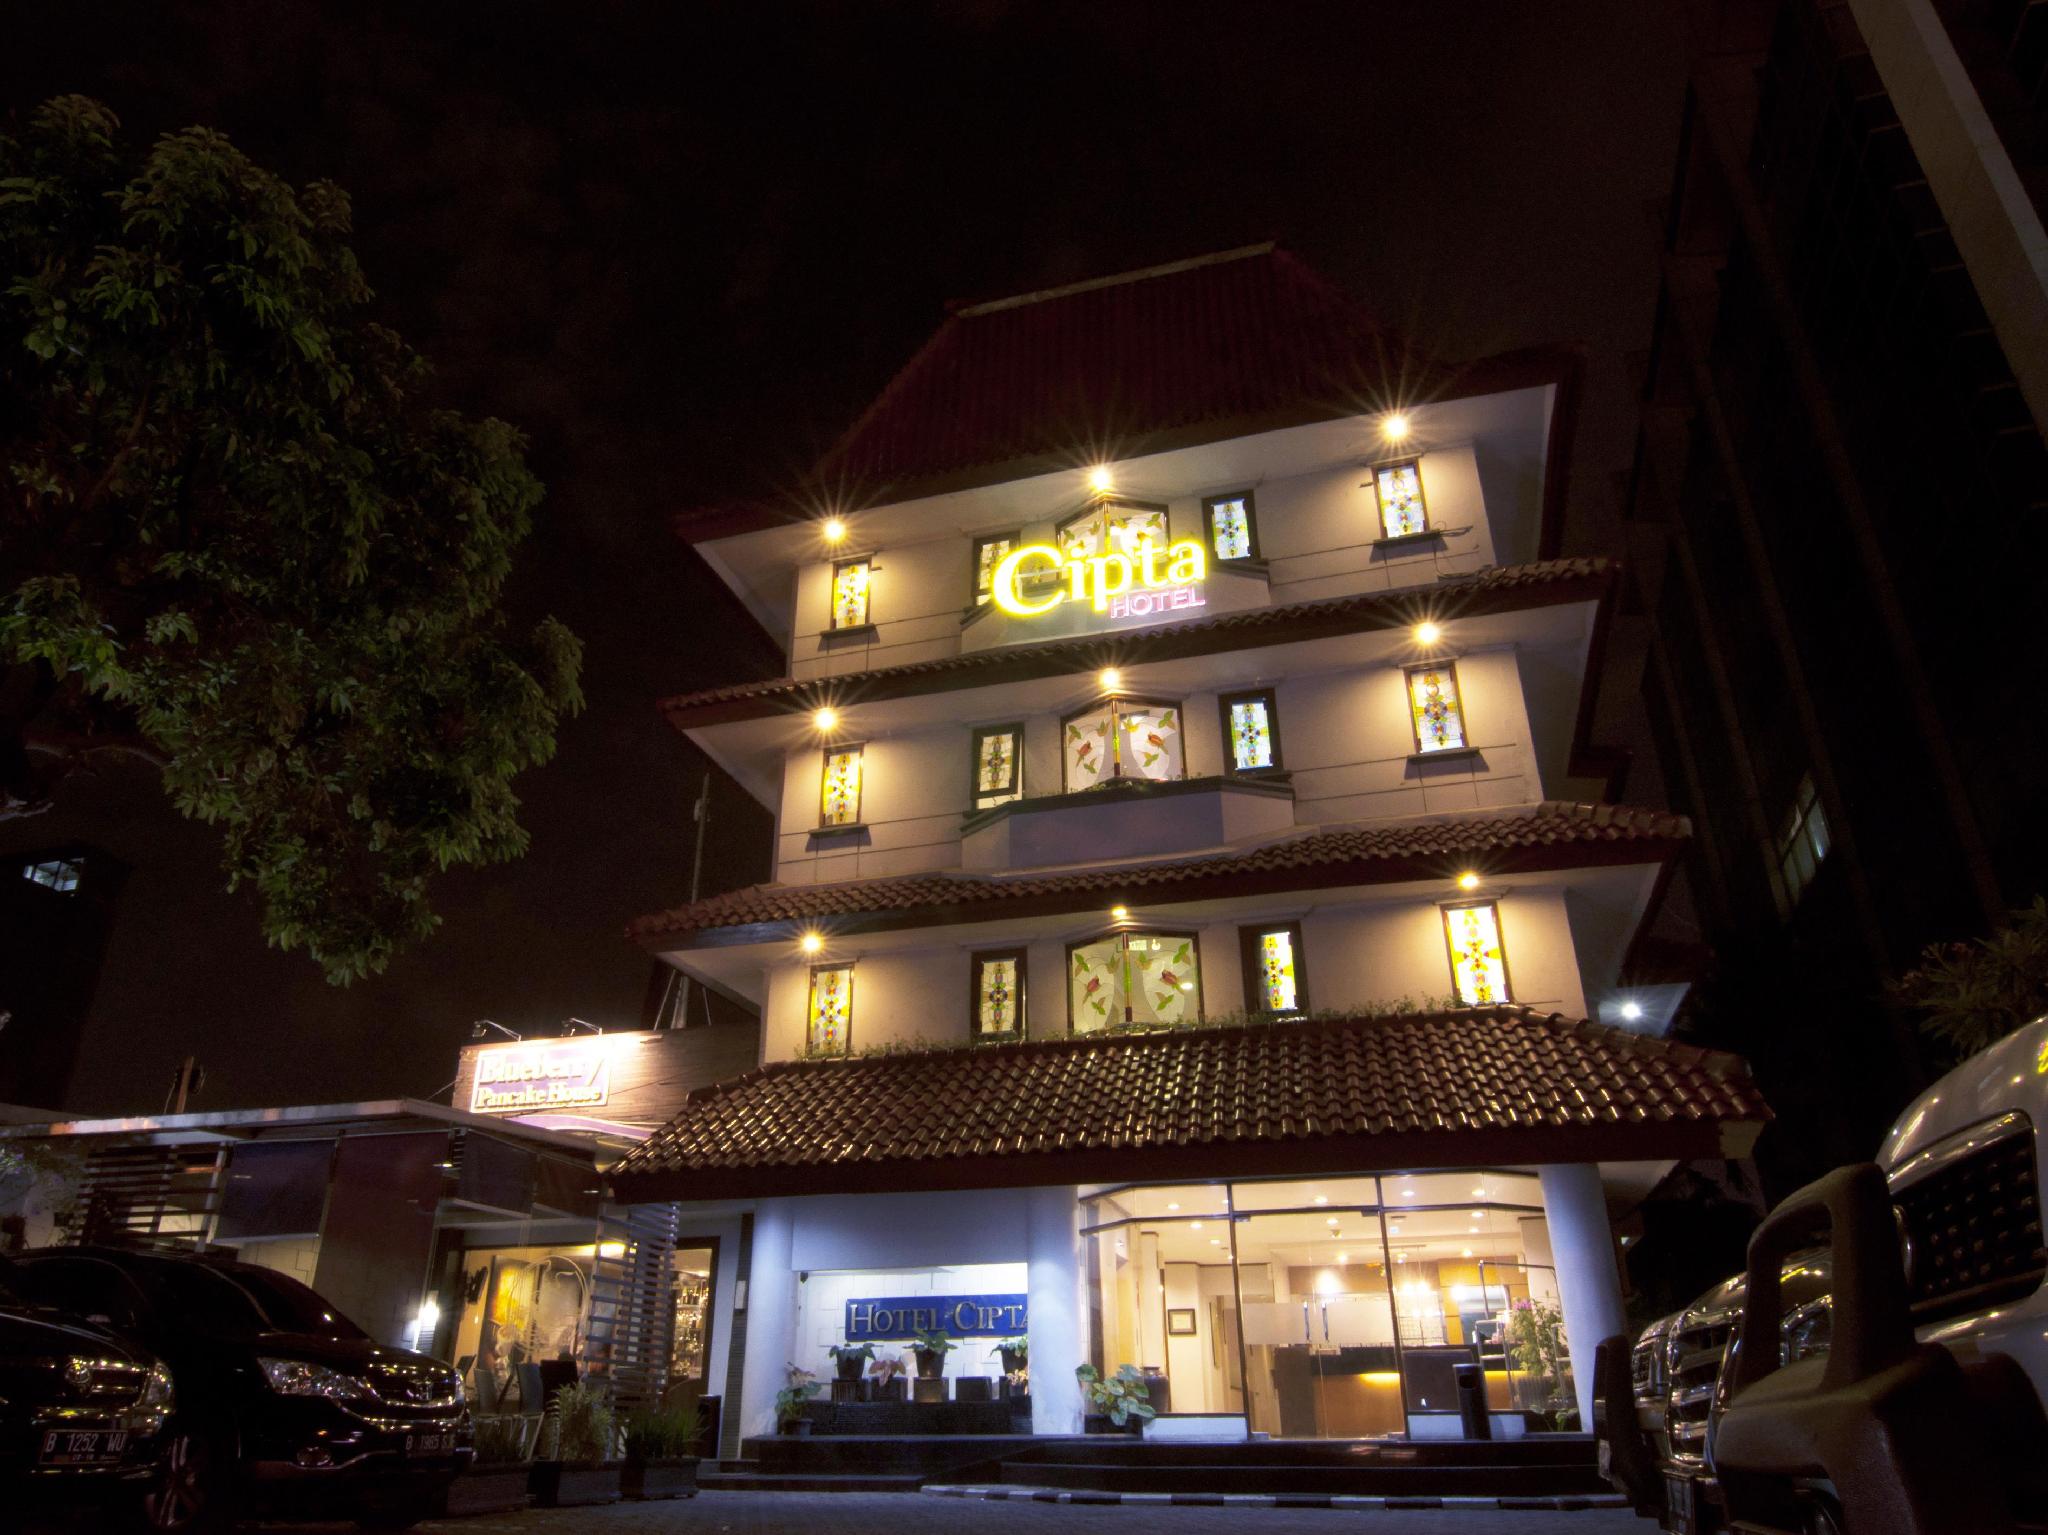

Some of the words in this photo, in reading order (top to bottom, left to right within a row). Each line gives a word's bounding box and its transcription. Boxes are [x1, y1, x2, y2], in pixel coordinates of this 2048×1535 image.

[992, 540, 1207, 616] Cipta
[1110, 586, 1206, 618] HOTEL
[848, 1303, 946, 1333] HOTEL
[46, 1432, 57, 1452] B
